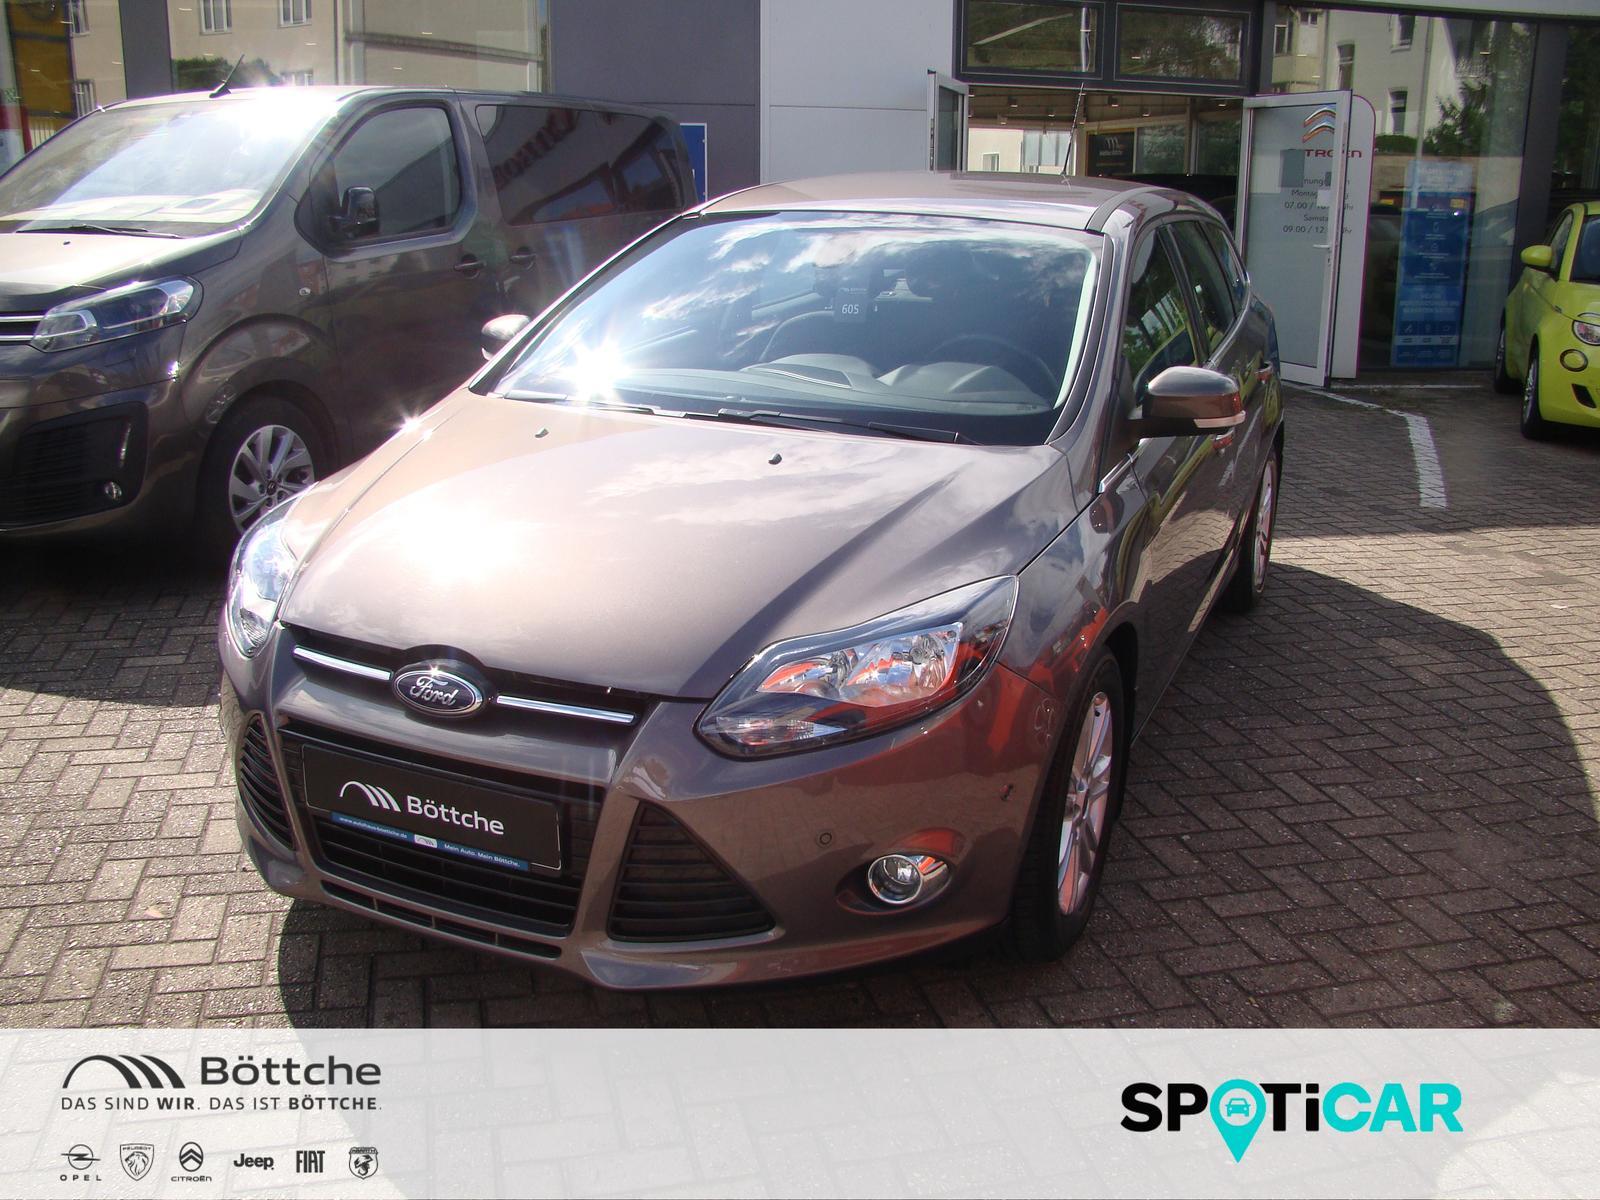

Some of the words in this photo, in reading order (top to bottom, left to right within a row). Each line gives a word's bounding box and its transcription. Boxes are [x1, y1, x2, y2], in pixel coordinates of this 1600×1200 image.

[841, 303, 859, 314] 605
[409, 676, 459, 706] Ford
[406, 795, 505, 835] Böttche
[444, 843, 460, 852] Mein
[477, 851, 493, 860] Mein
